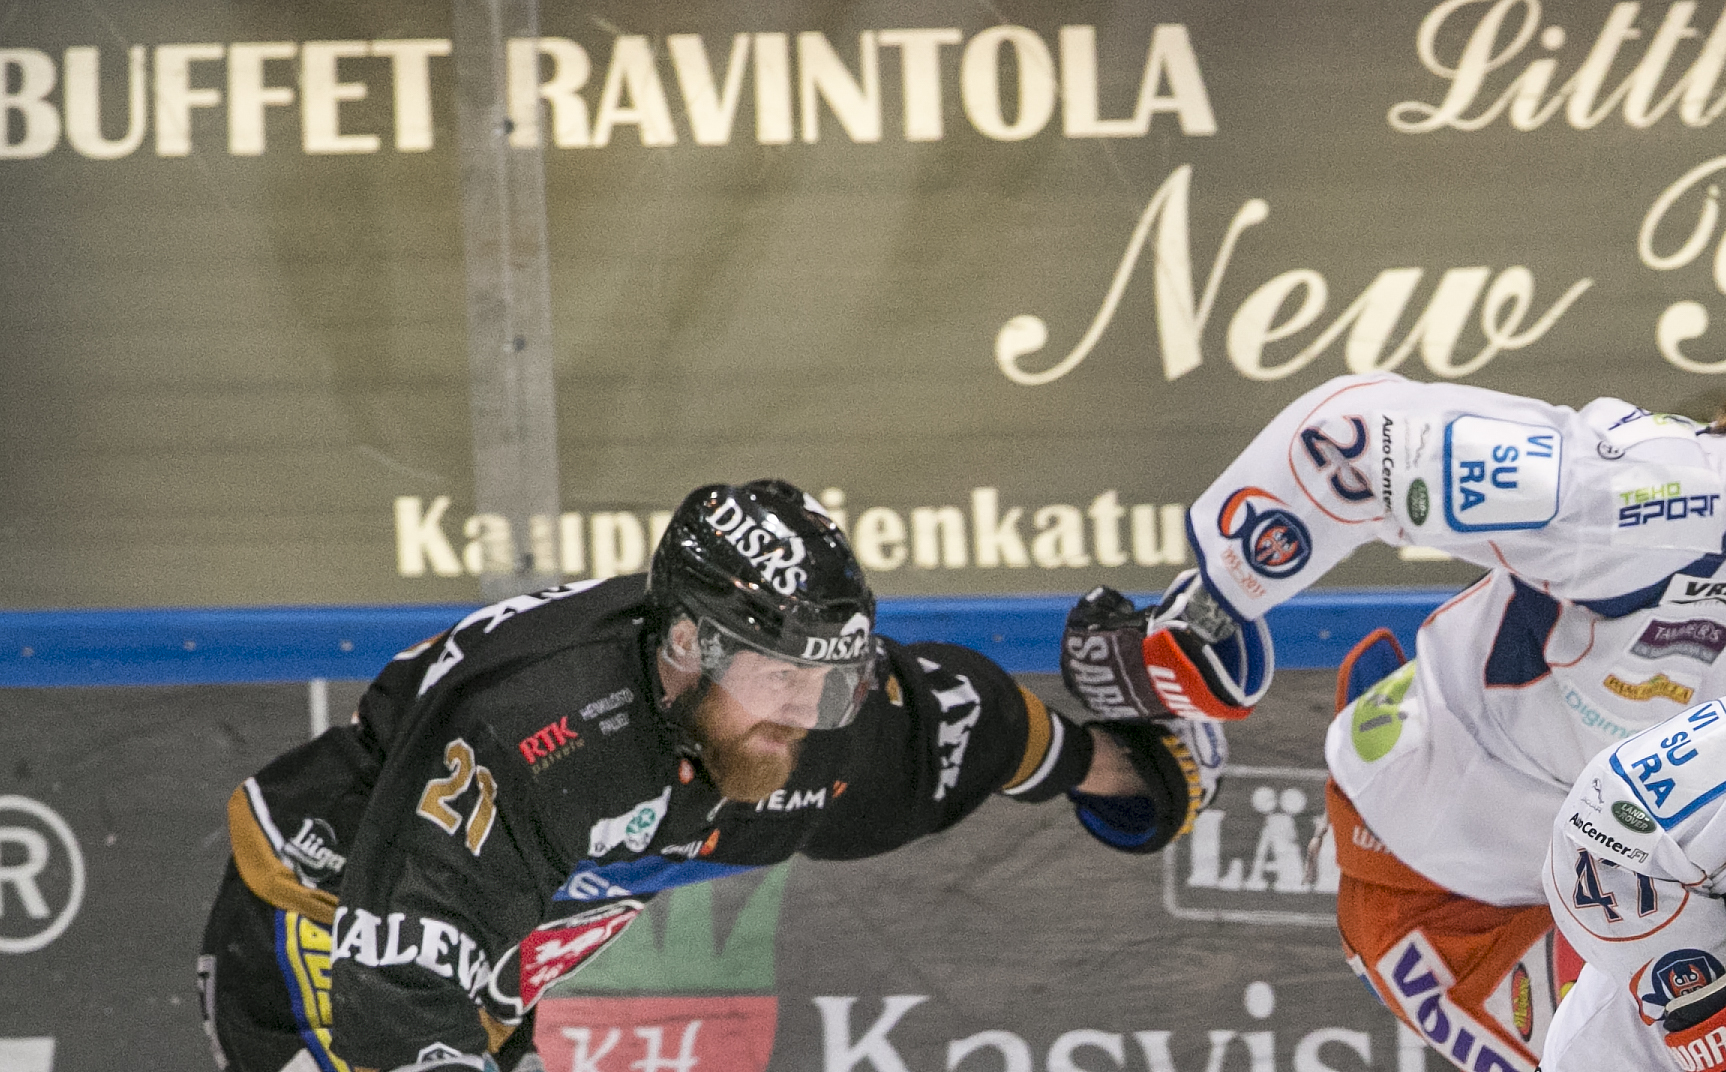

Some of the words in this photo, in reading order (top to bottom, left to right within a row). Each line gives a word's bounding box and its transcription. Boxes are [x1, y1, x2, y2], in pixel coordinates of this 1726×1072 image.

[0, 40, 450, 160] BUFFET
[505, 24, 1218, 150] RAVINTOLA
[995, 164, 1593, 385] New
[395, 487, 1187, 580] Kaupienkatu
[518, 715, 579, 765] RTK
[1660, 730, 1699, 767] SU
[1687, 702, 1720, 732] VI
[416, 738, 498, 857] 21
[1630, 752, 1677, 810] RA
[1572, 846, 1659, 924] 47
